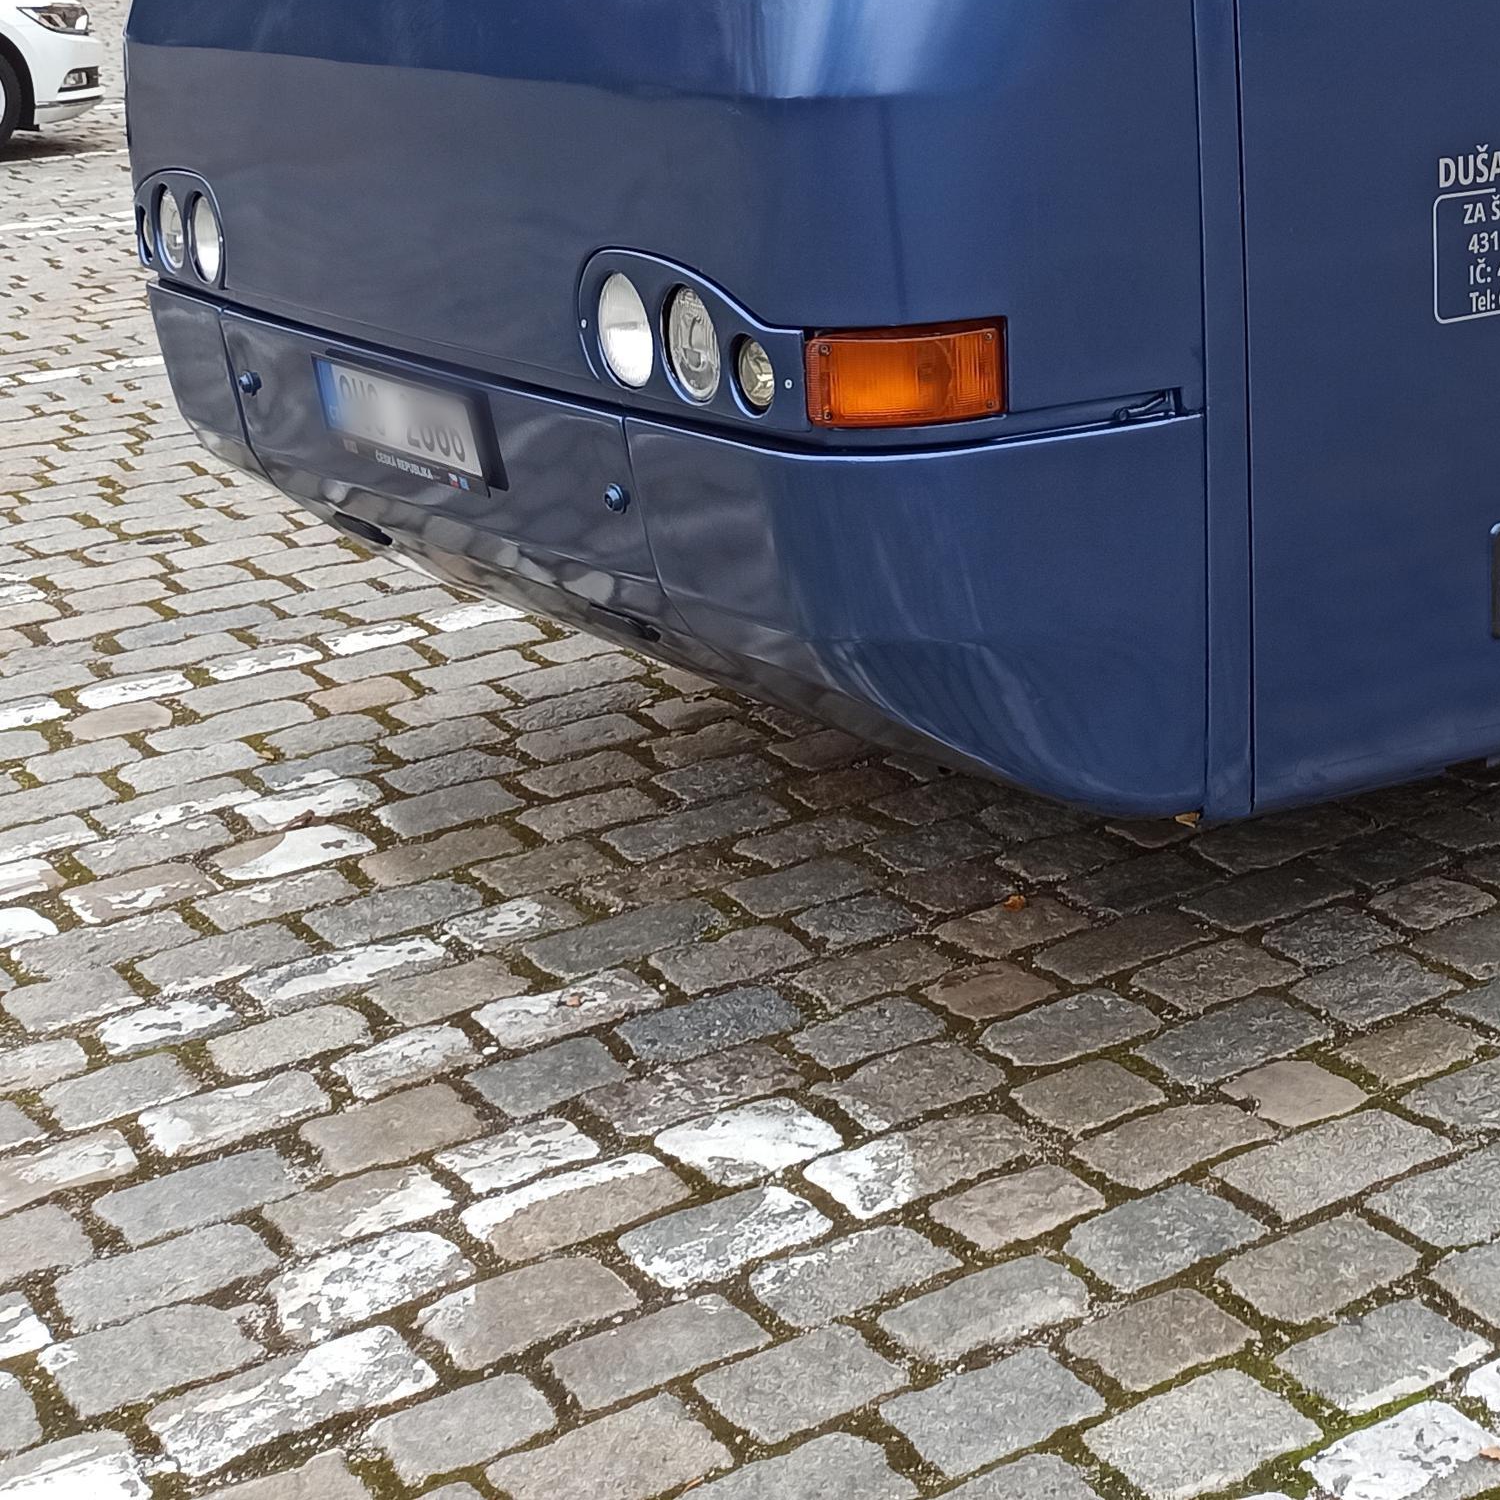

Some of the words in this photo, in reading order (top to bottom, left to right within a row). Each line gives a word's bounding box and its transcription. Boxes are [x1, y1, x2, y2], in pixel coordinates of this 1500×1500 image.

[1463, 202, 1486, 225] ZA
[1468, 230, 1499, 254] 431
[1469, 258, 1492, 285] IČ:
[1469, 288, 1496, 313] Tel:
